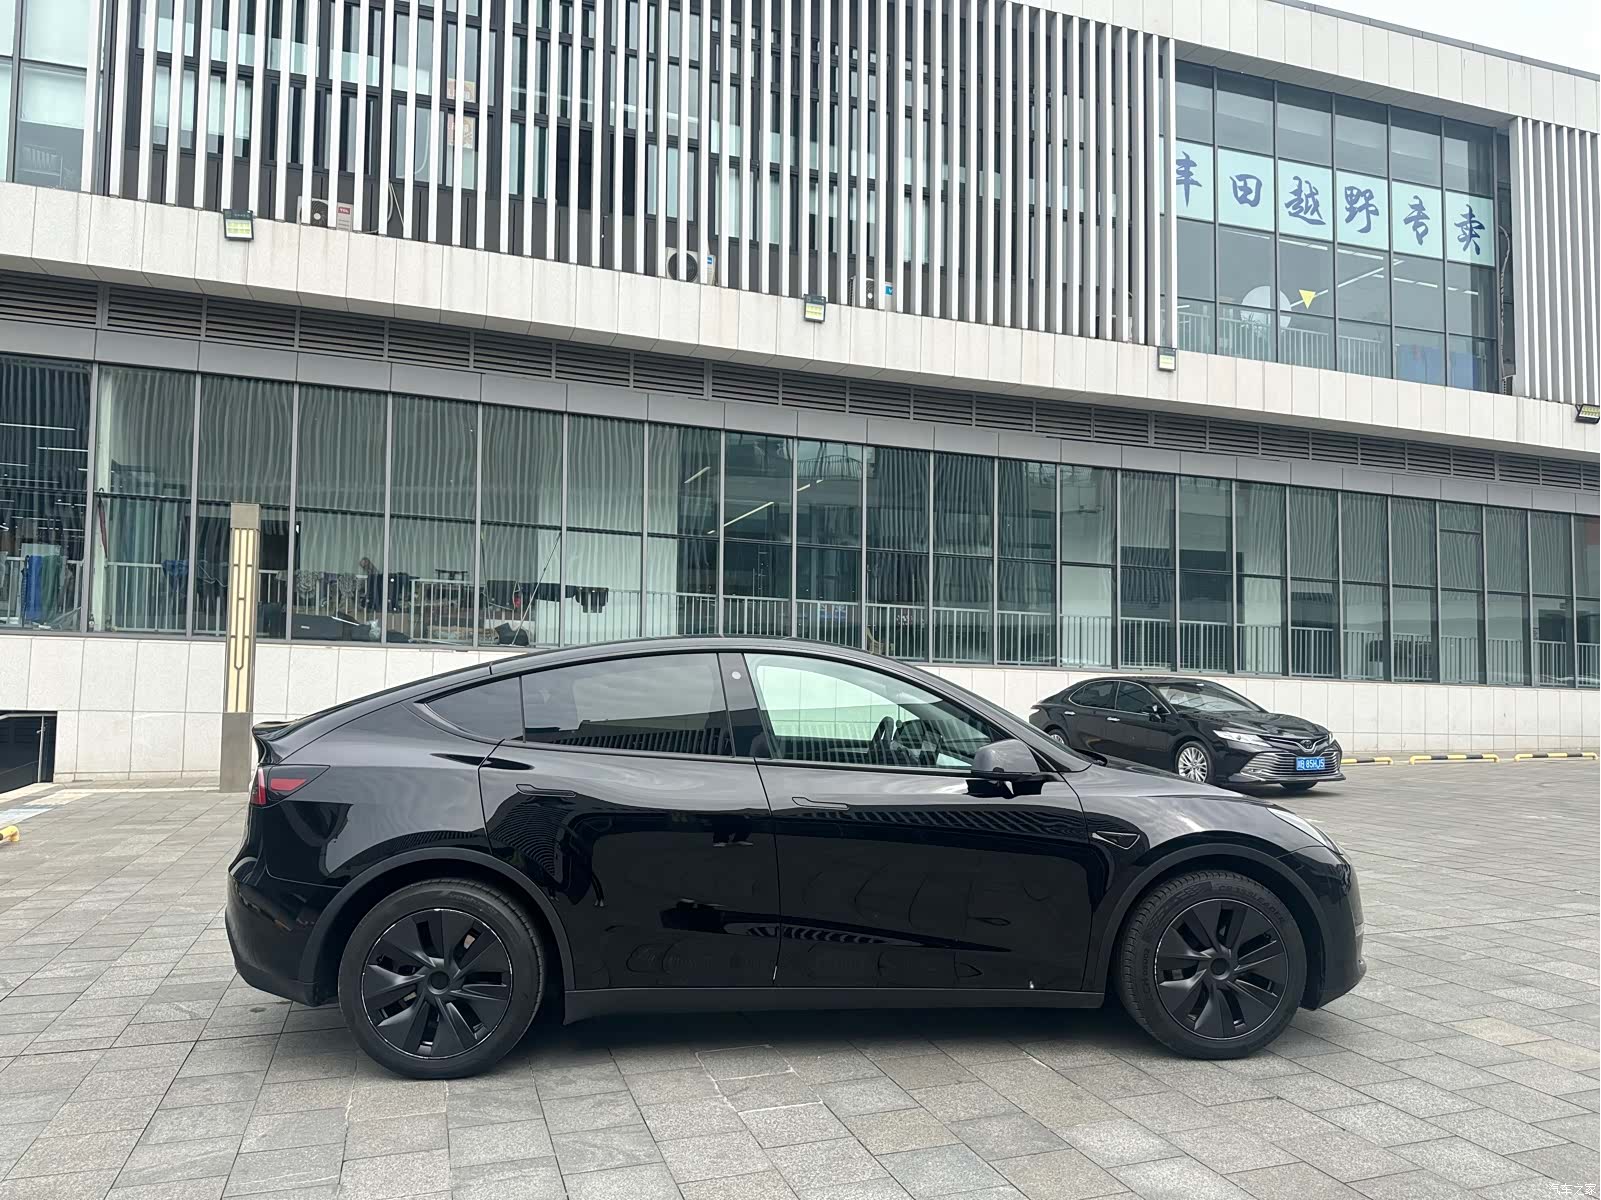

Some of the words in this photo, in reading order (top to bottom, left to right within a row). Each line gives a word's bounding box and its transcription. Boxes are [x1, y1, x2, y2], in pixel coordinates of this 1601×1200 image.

[1176, 151, 1486, 255] 丰田越野专卖
